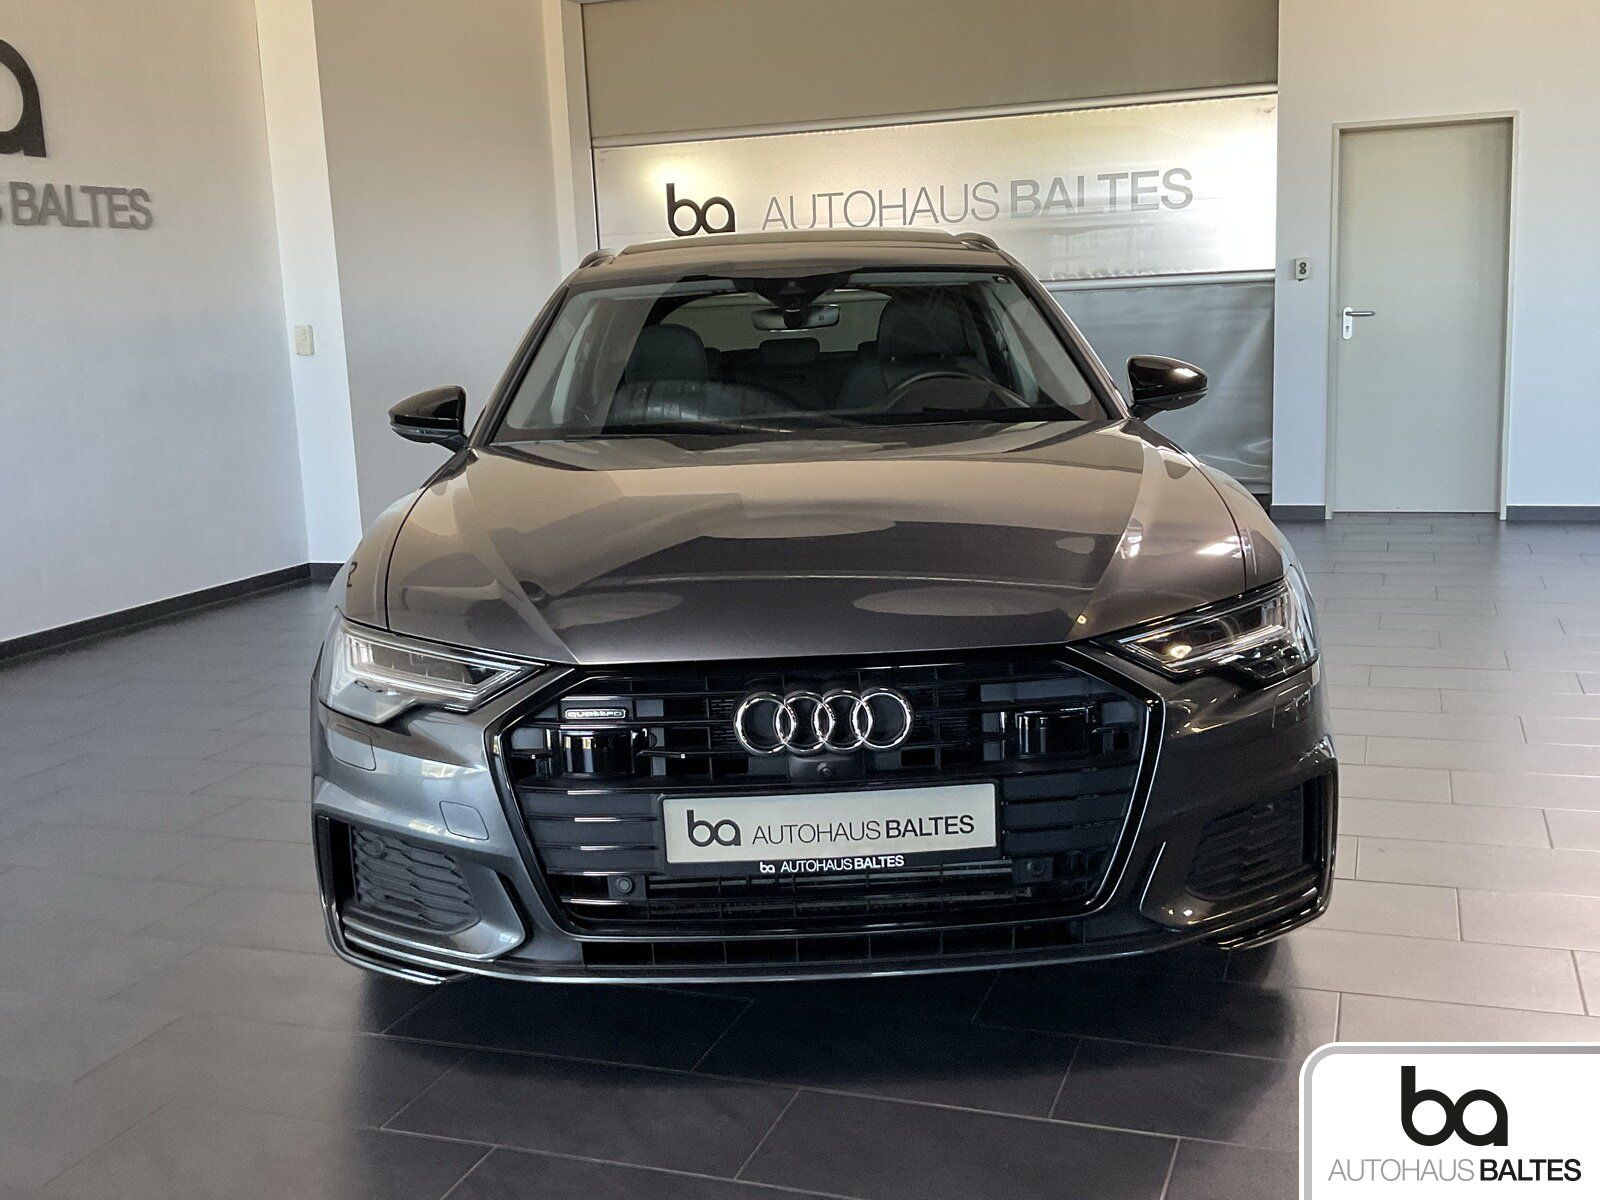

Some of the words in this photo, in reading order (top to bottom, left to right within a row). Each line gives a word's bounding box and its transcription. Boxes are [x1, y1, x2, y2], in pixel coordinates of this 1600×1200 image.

[9, 181, 153, 230] BALTES
[666, 183, 736, 237] ba
[761, 182, 999, 231] AUTOHAUS
[1010, 168, 1193, 219] BALTES
[566, 709, 624, 719] quattro
[686, 809, 742, 847] ba
[752, 820, 881, 845] AUTOHAUS
[885, 814, 975, 840] BALTES
[759, 861, 776, 874] ba
[780, 858, 853, 873] AUTOHAUS
[854, 854, 905, 870] BALTES
